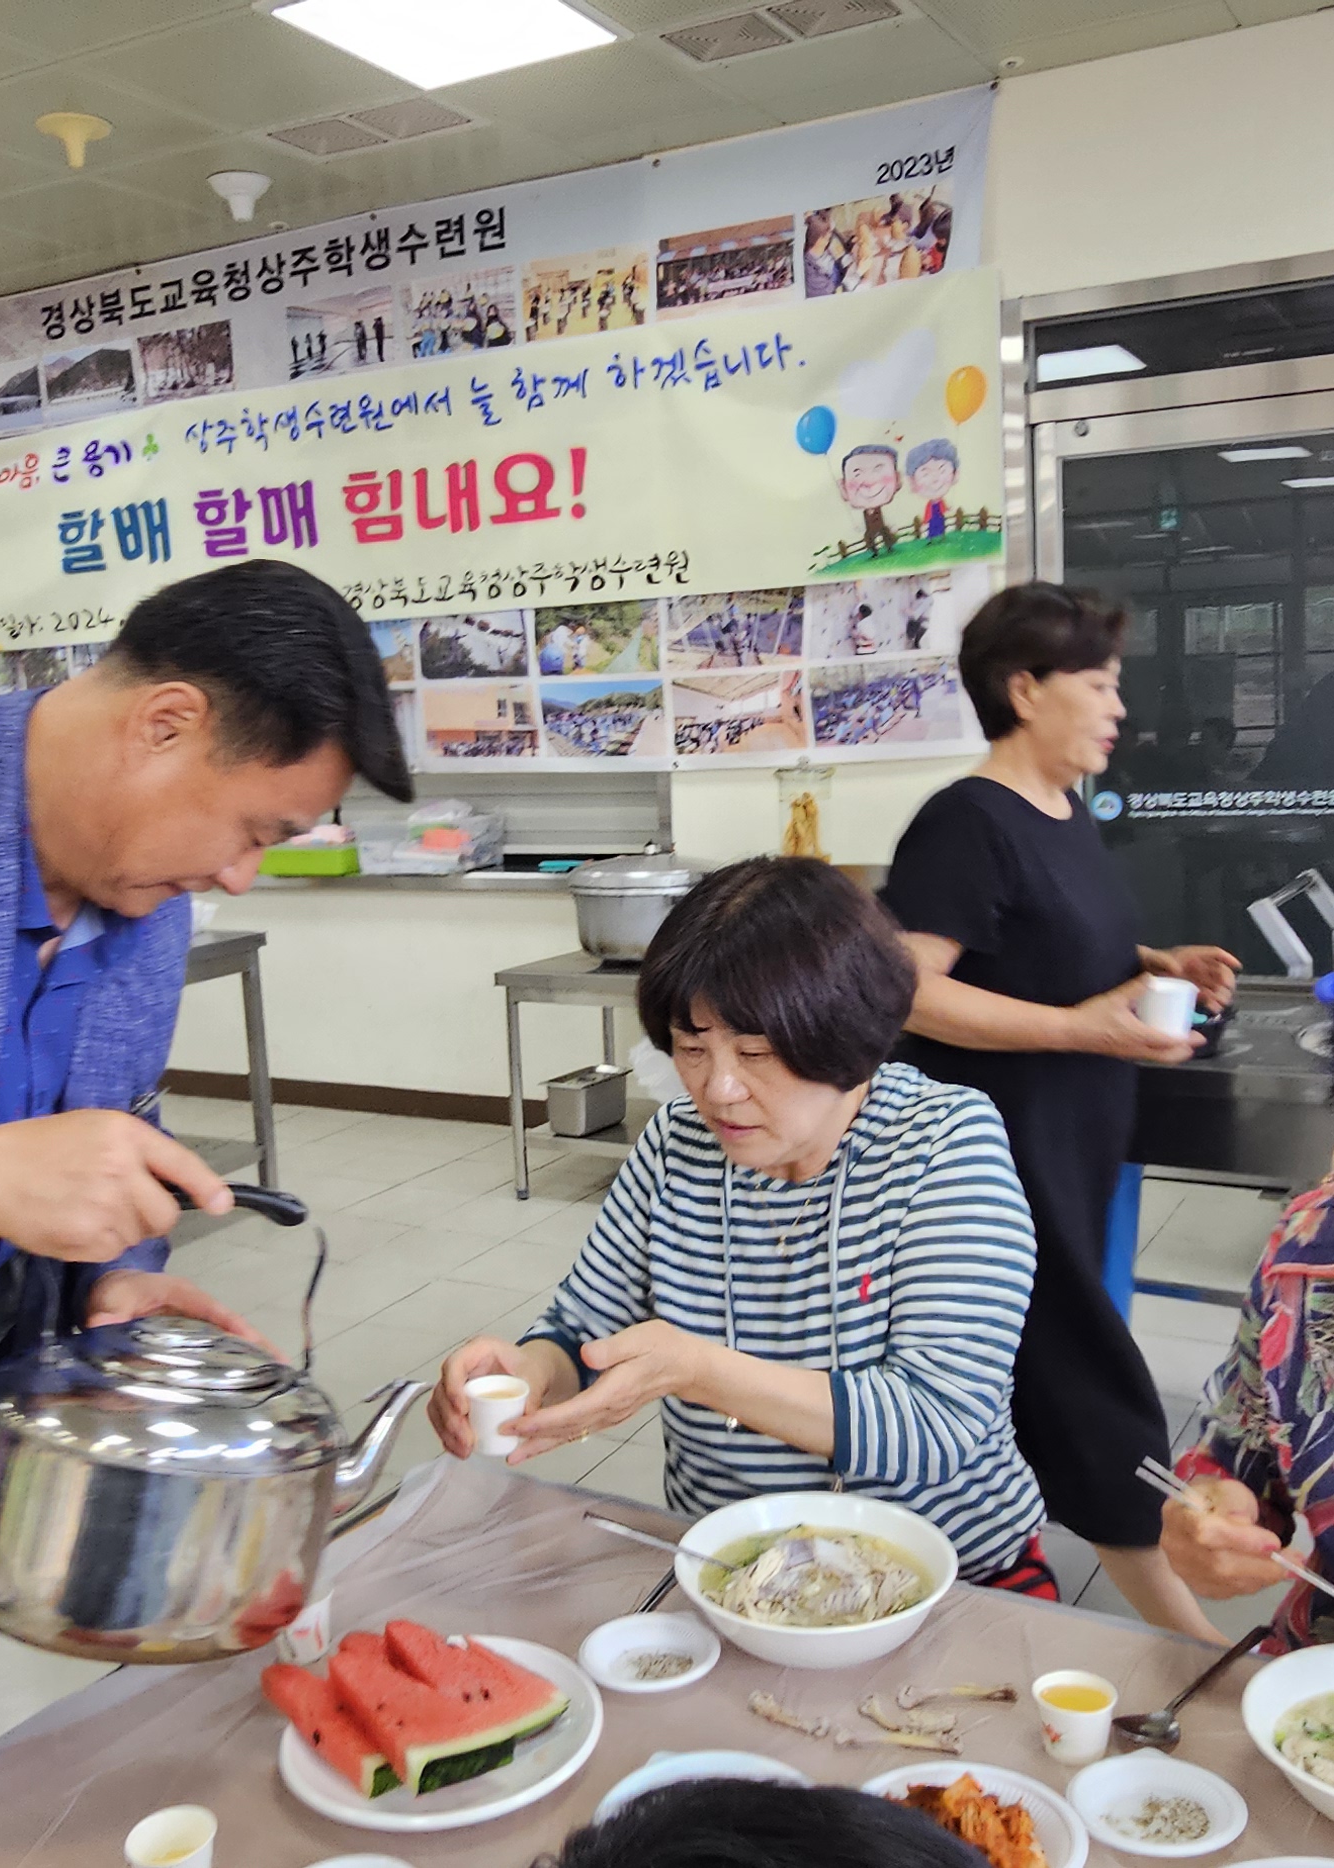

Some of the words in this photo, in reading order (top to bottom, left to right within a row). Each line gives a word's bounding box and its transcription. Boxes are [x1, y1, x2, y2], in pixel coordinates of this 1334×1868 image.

[876, 145, 955, 185] 2023년
[39, 205, 508, 341] 경상북도교육청상주학생수련원
[186, 386, 453, 454] 상주학생수련원에서
[470, 376, 502, 426] 늘
[511, 368, 589, 412] 함께
[606, 333, 806, 391] 하겠습니다.
[52, 446, 71, 483] 큰
[82, 440, 132, 477] 용기
[58, 496, 173, 574] 할배
[194, 479, 320, 558] 할매
[342, 447, 588, 543] 힘내요!
